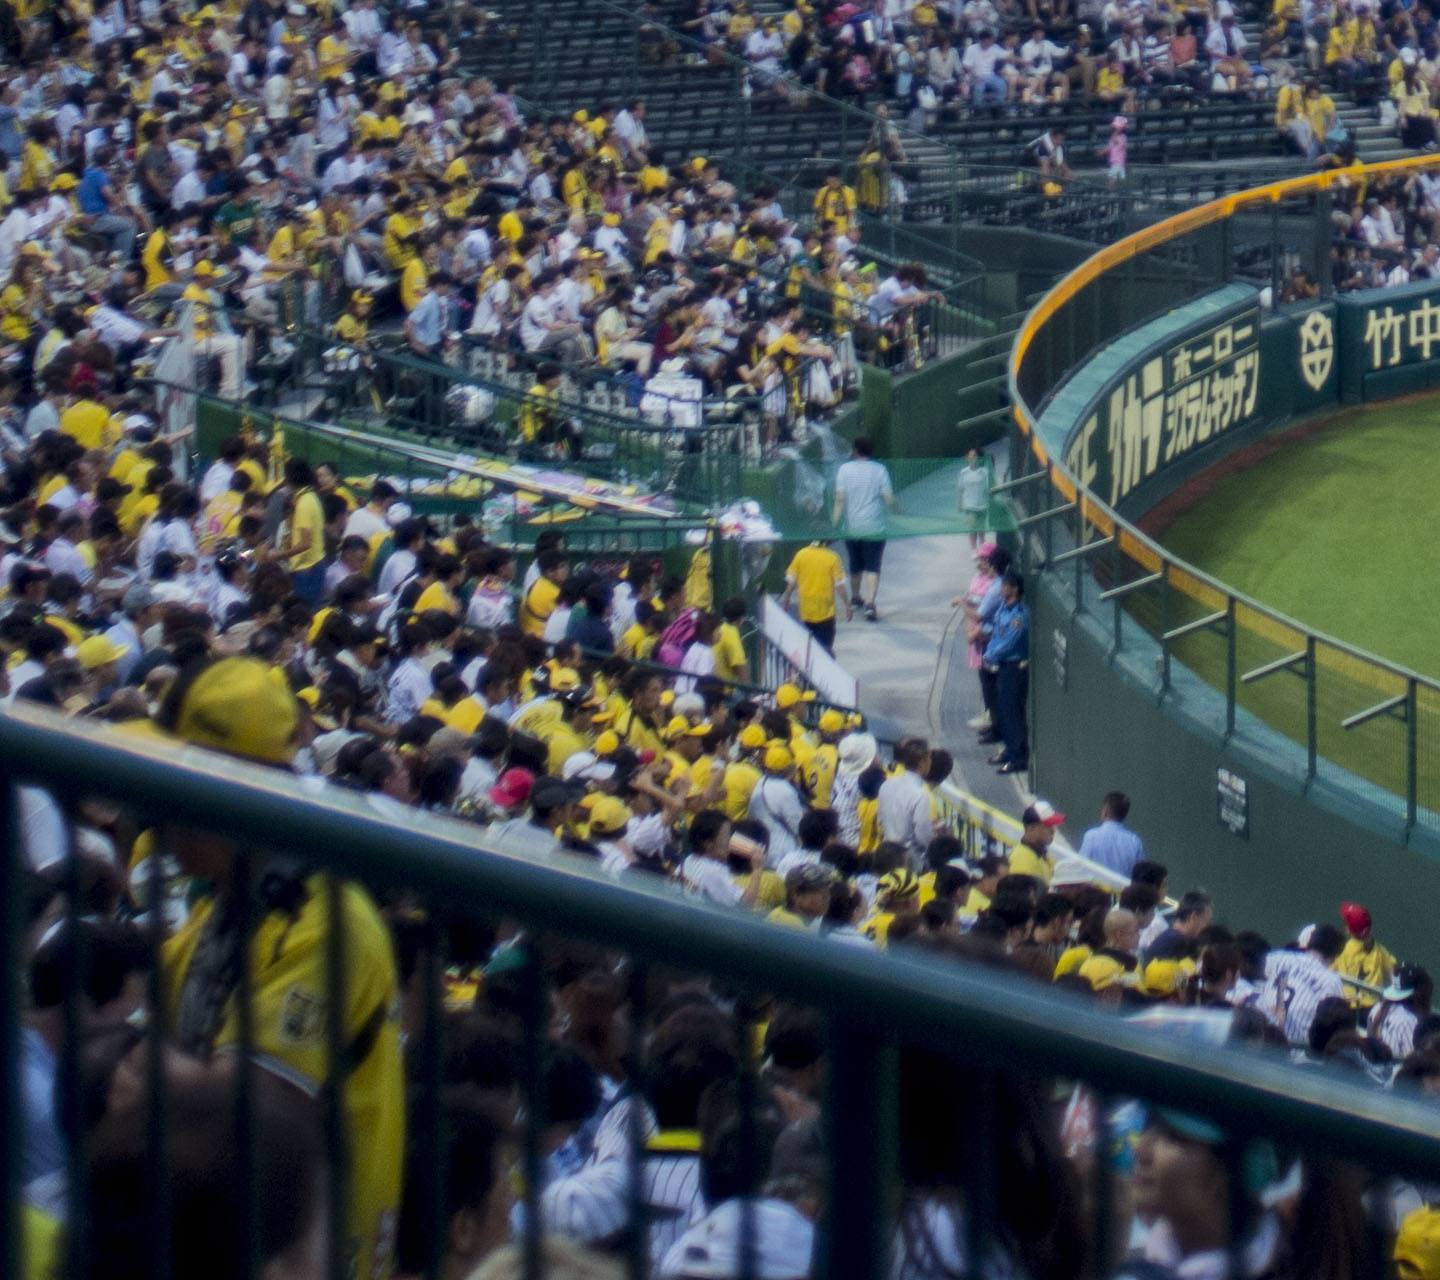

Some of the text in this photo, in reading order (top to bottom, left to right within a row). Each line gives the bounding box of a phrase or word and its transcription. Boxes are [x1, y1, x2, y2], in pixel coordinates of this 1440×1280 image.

[1164, 348, 1260, 464] システムキッチン
[1171, 324, 1255, 384] ホーロー
[1107, 356, 1165, 508] タカラ
